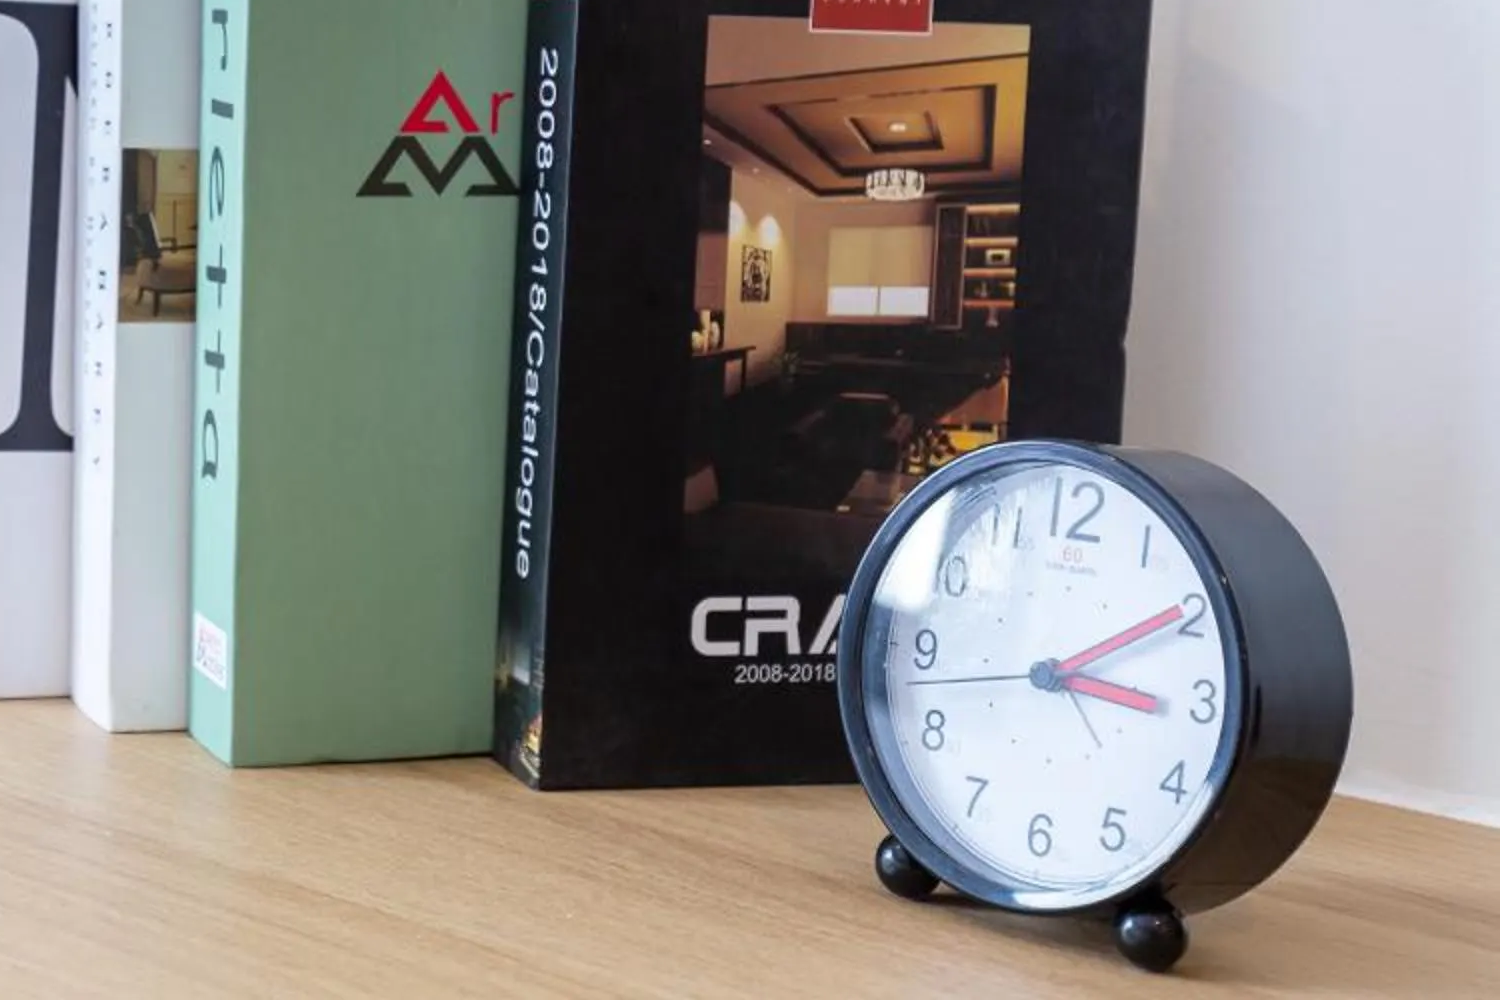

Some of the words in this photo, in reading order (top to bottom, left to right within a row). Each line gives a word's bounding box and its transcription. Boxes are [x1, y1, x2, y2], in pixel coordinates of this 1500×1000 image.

[515, 47, 559, 579] 2008-2018/Catalogue
[991, 502, 1023, 549] 11
[1049, 477, 1106, 544] 12
[1141, 525, 1152, 568] 1
[1176, 593, 1208, 638] 2
[914, 629, 939, 670] 9
[734, 664, 836, 684] 2008-2018
[1189, 680, 1217, 725] 3
[921, 709, 946, 751] 8
[965, 776, 989, 818] 7
[1159, 760, 1188, 805] 4
[1027, 814, 1053, 857] 6
[1099, 807, 1128, 852] 5
